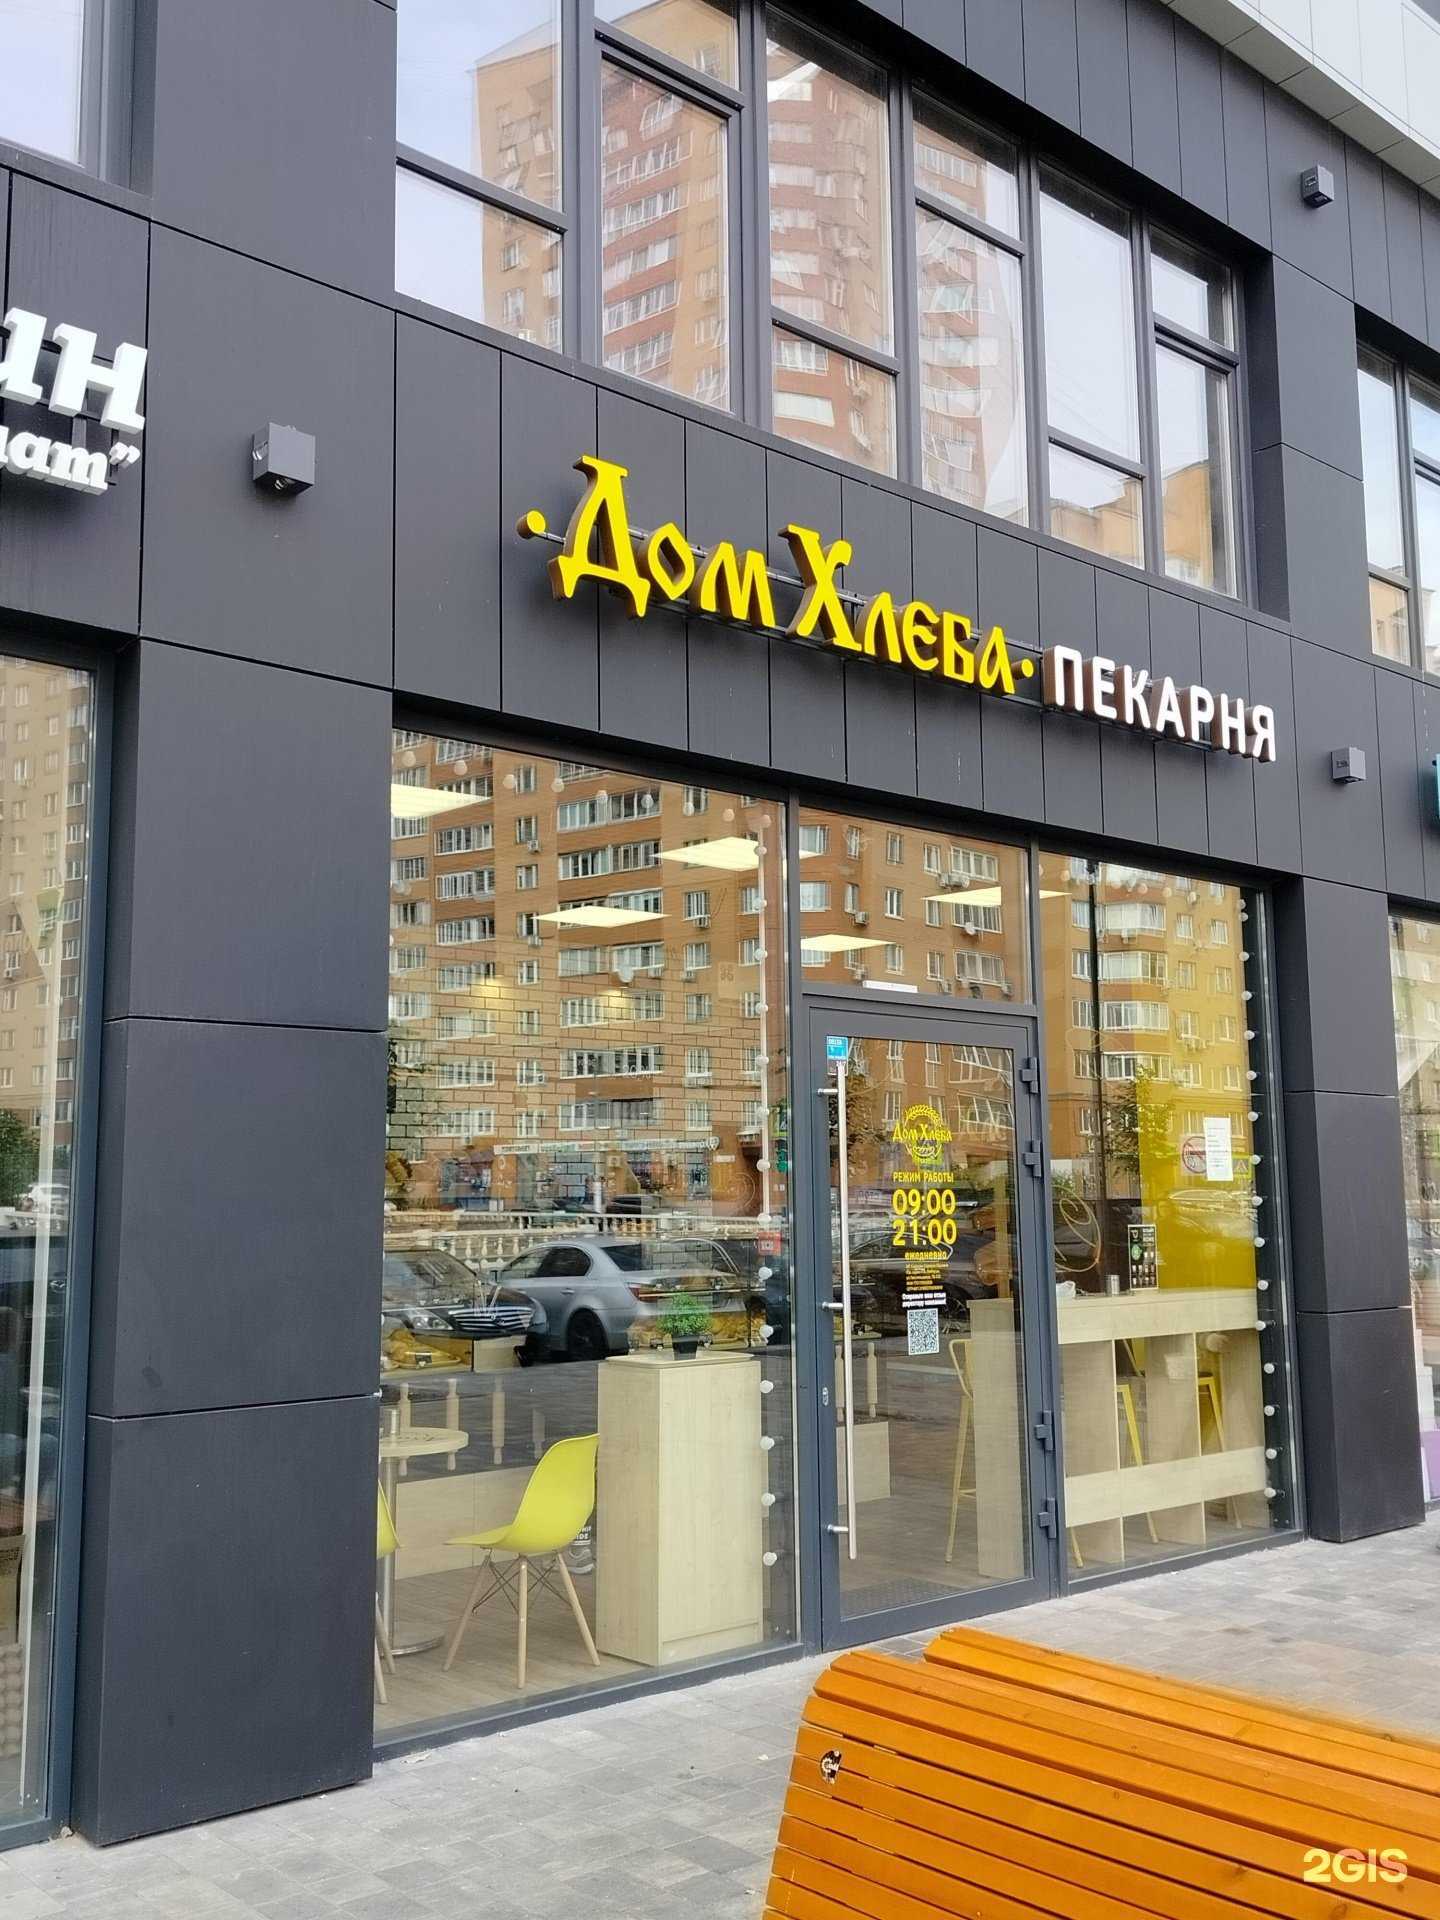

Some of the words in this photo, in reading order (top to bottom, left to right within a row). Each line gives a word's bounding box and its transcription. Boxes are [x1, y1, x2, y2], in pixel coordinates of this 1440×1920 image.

[1050, 644, 1277, 763] ПЕКАРНЯ
[893, 1172, 921, 1183] РЕЖИМ
[923, 1172, 955, 1183] РАБОТЫ
[892, 1189, 956, 1216] 09:00
[892, 1218, 957, 1246] 21:00
